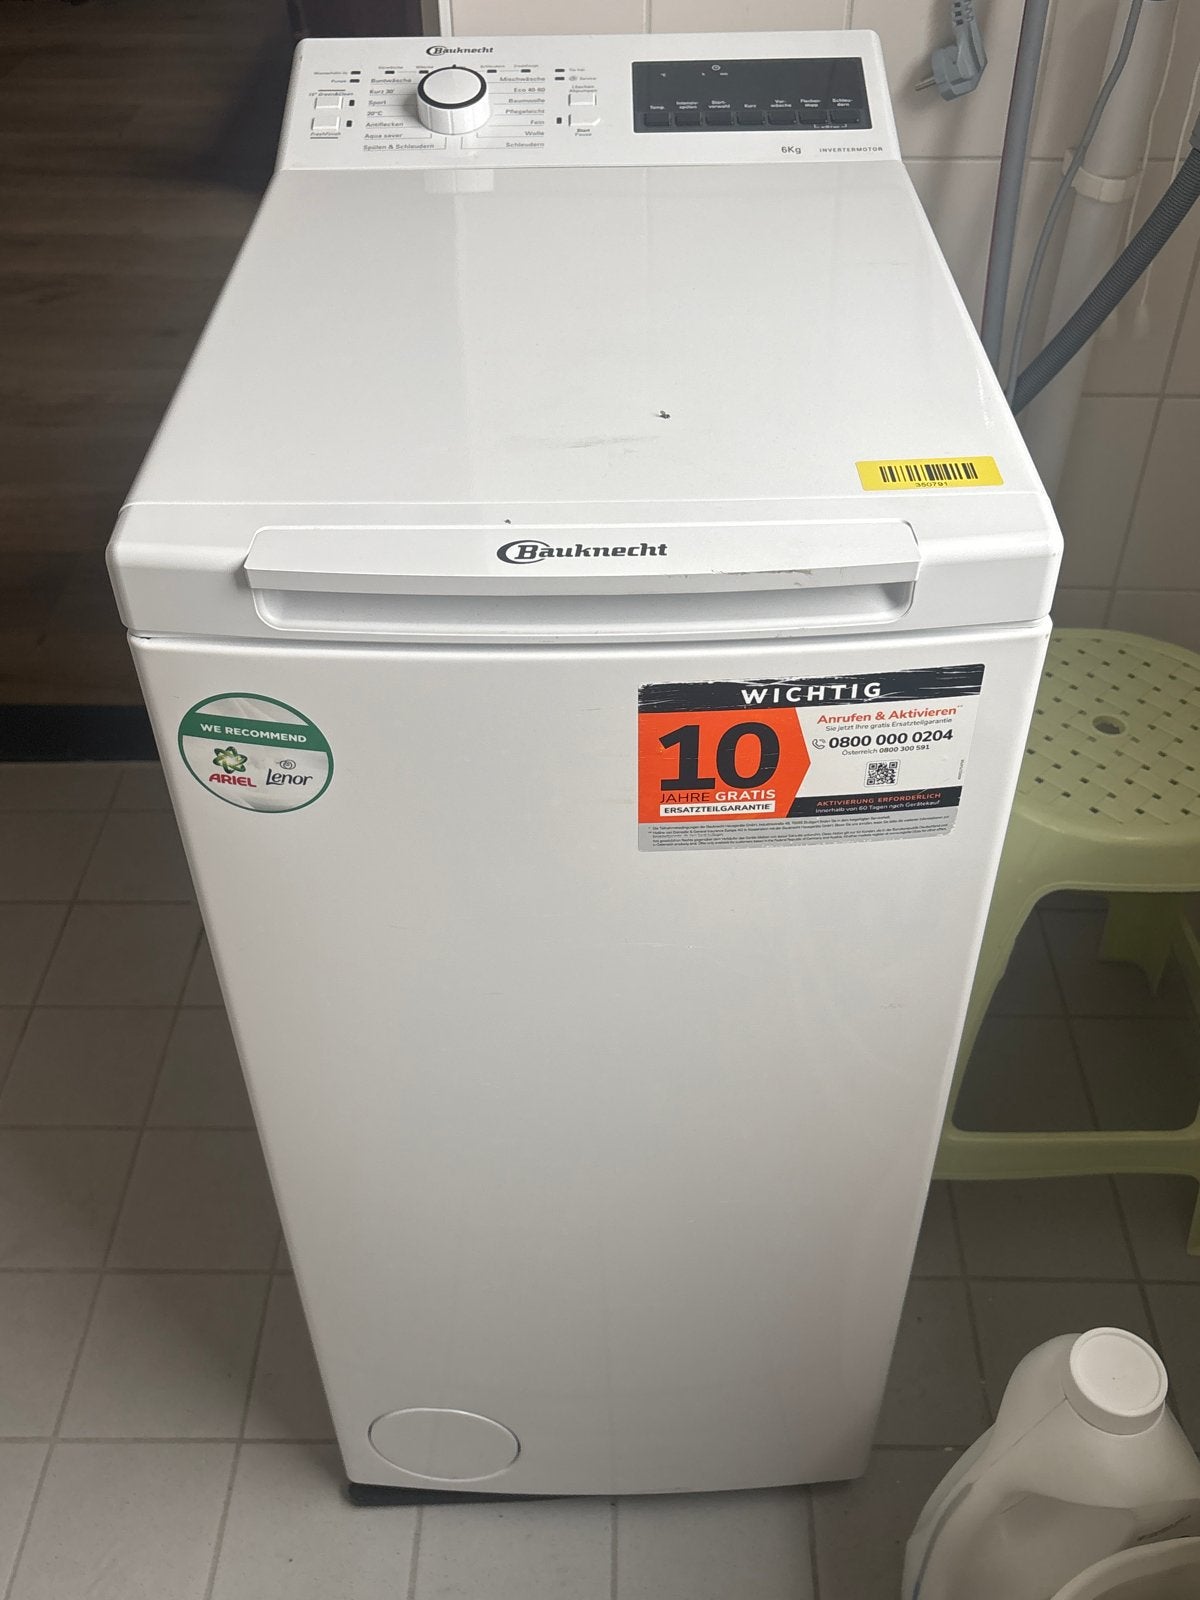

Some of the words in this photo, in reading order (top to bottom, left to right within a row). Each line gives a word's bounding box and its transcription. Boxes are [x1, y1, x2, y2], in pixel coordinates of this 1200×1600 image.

[426, 45, 494, 56] Bauknecht
[781, 145, 802, 155] 6Kg
[497, 540, 668, 564] Bauknecht
[741, 682, 881, 705] WICHTIG
[817, 713, 871, 725] Anrufen
[875, 711, 885, 721] &
[888, 707, 957, 720] Aktivieren
[837, 723, 854, 732] jetzt
[855, 722, 868, 730] Ihre
[870, 721, 891, 730] gratis
[891, 718, 953, 728] Ersatzteilgarantie
[200, 723, 222, 734] WE
[225, 726, 307, 743] RECOMMEND
[828, 735, 872, 749] 0800
[876, 733, 908, 746] 000
[912, 729, 953, 743] 0204
[659, 721, 781, 791] 10
[842, 748, 878, 756] Österreich
[879, 746, 899, 754] 0800
[208, 773, 257, 788] ARIEL
[266, 768, 313, 786] Lenor
[660, 792, 710, 804] JAHRE
[715, 789, 776, 801] GRATIS
[816, 798, 874, 807] AKTIVIERUNG
[878, 792, 941, 803] ERFORDERLICH
[664, 803, 772, 814] ERSATZTEILGARANTIE
[815, 805, 845, 813] Innerhalb
[869, 803, 888, 812] Tagen
[888, 801, 904, 810] nach
[905, 799, 941, 808] Gerätekauf
